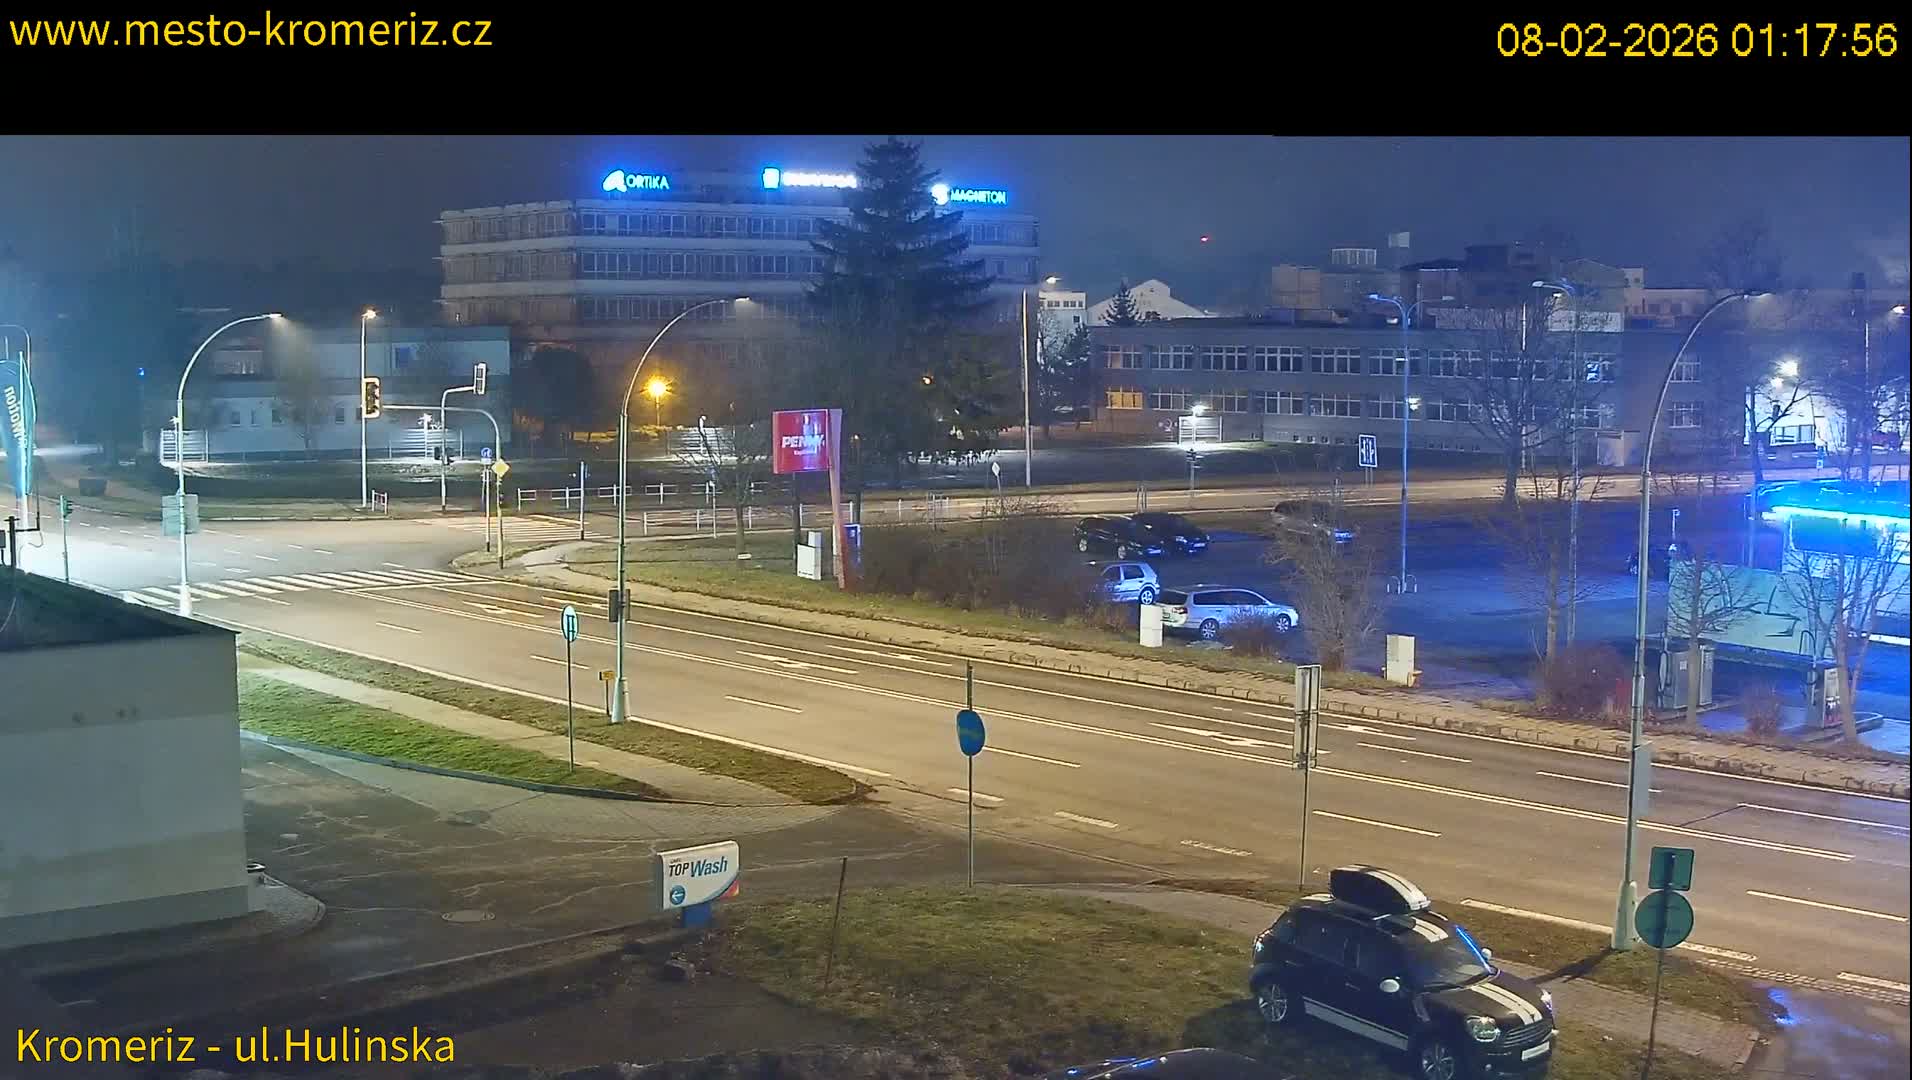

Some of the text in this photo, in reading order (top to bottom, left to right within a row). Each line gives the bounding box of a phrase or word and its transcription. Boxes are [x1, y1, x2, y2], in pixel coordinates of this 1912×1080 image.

[626, 173, 670, 190] ORTIKA
[669, 856, 728, 878] TOP Wash
